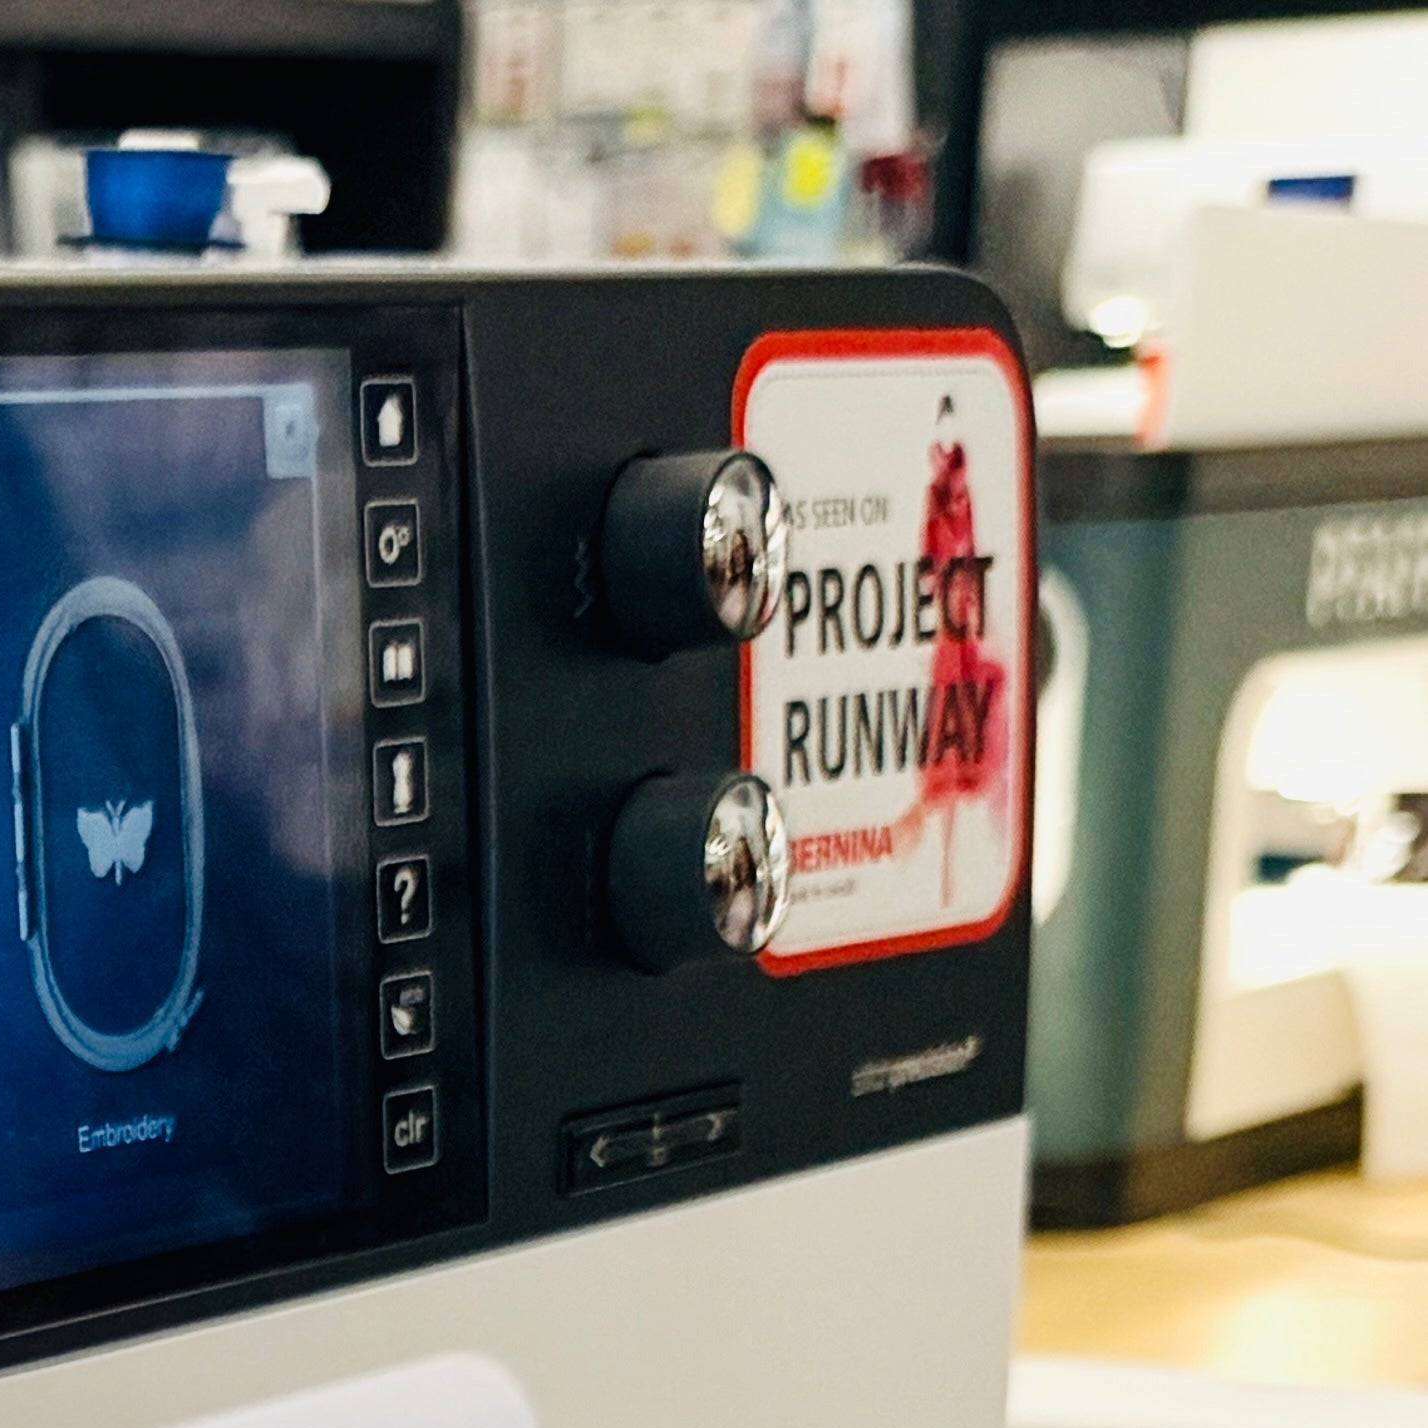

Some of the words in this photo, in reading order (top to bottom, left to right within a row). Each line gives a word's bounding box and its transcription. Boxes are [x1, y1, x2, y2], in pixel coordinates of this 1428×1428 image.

[810, 498, 856, 530] SEEN
[860, 495, 888, 527] ON
[784, 554, 996, 659] PROJECT
[784, 677, 997, 788] RUNWAY
[77, 1114, 175, 1153] Embroidery
[394, 1110, 429, 1147] clr
